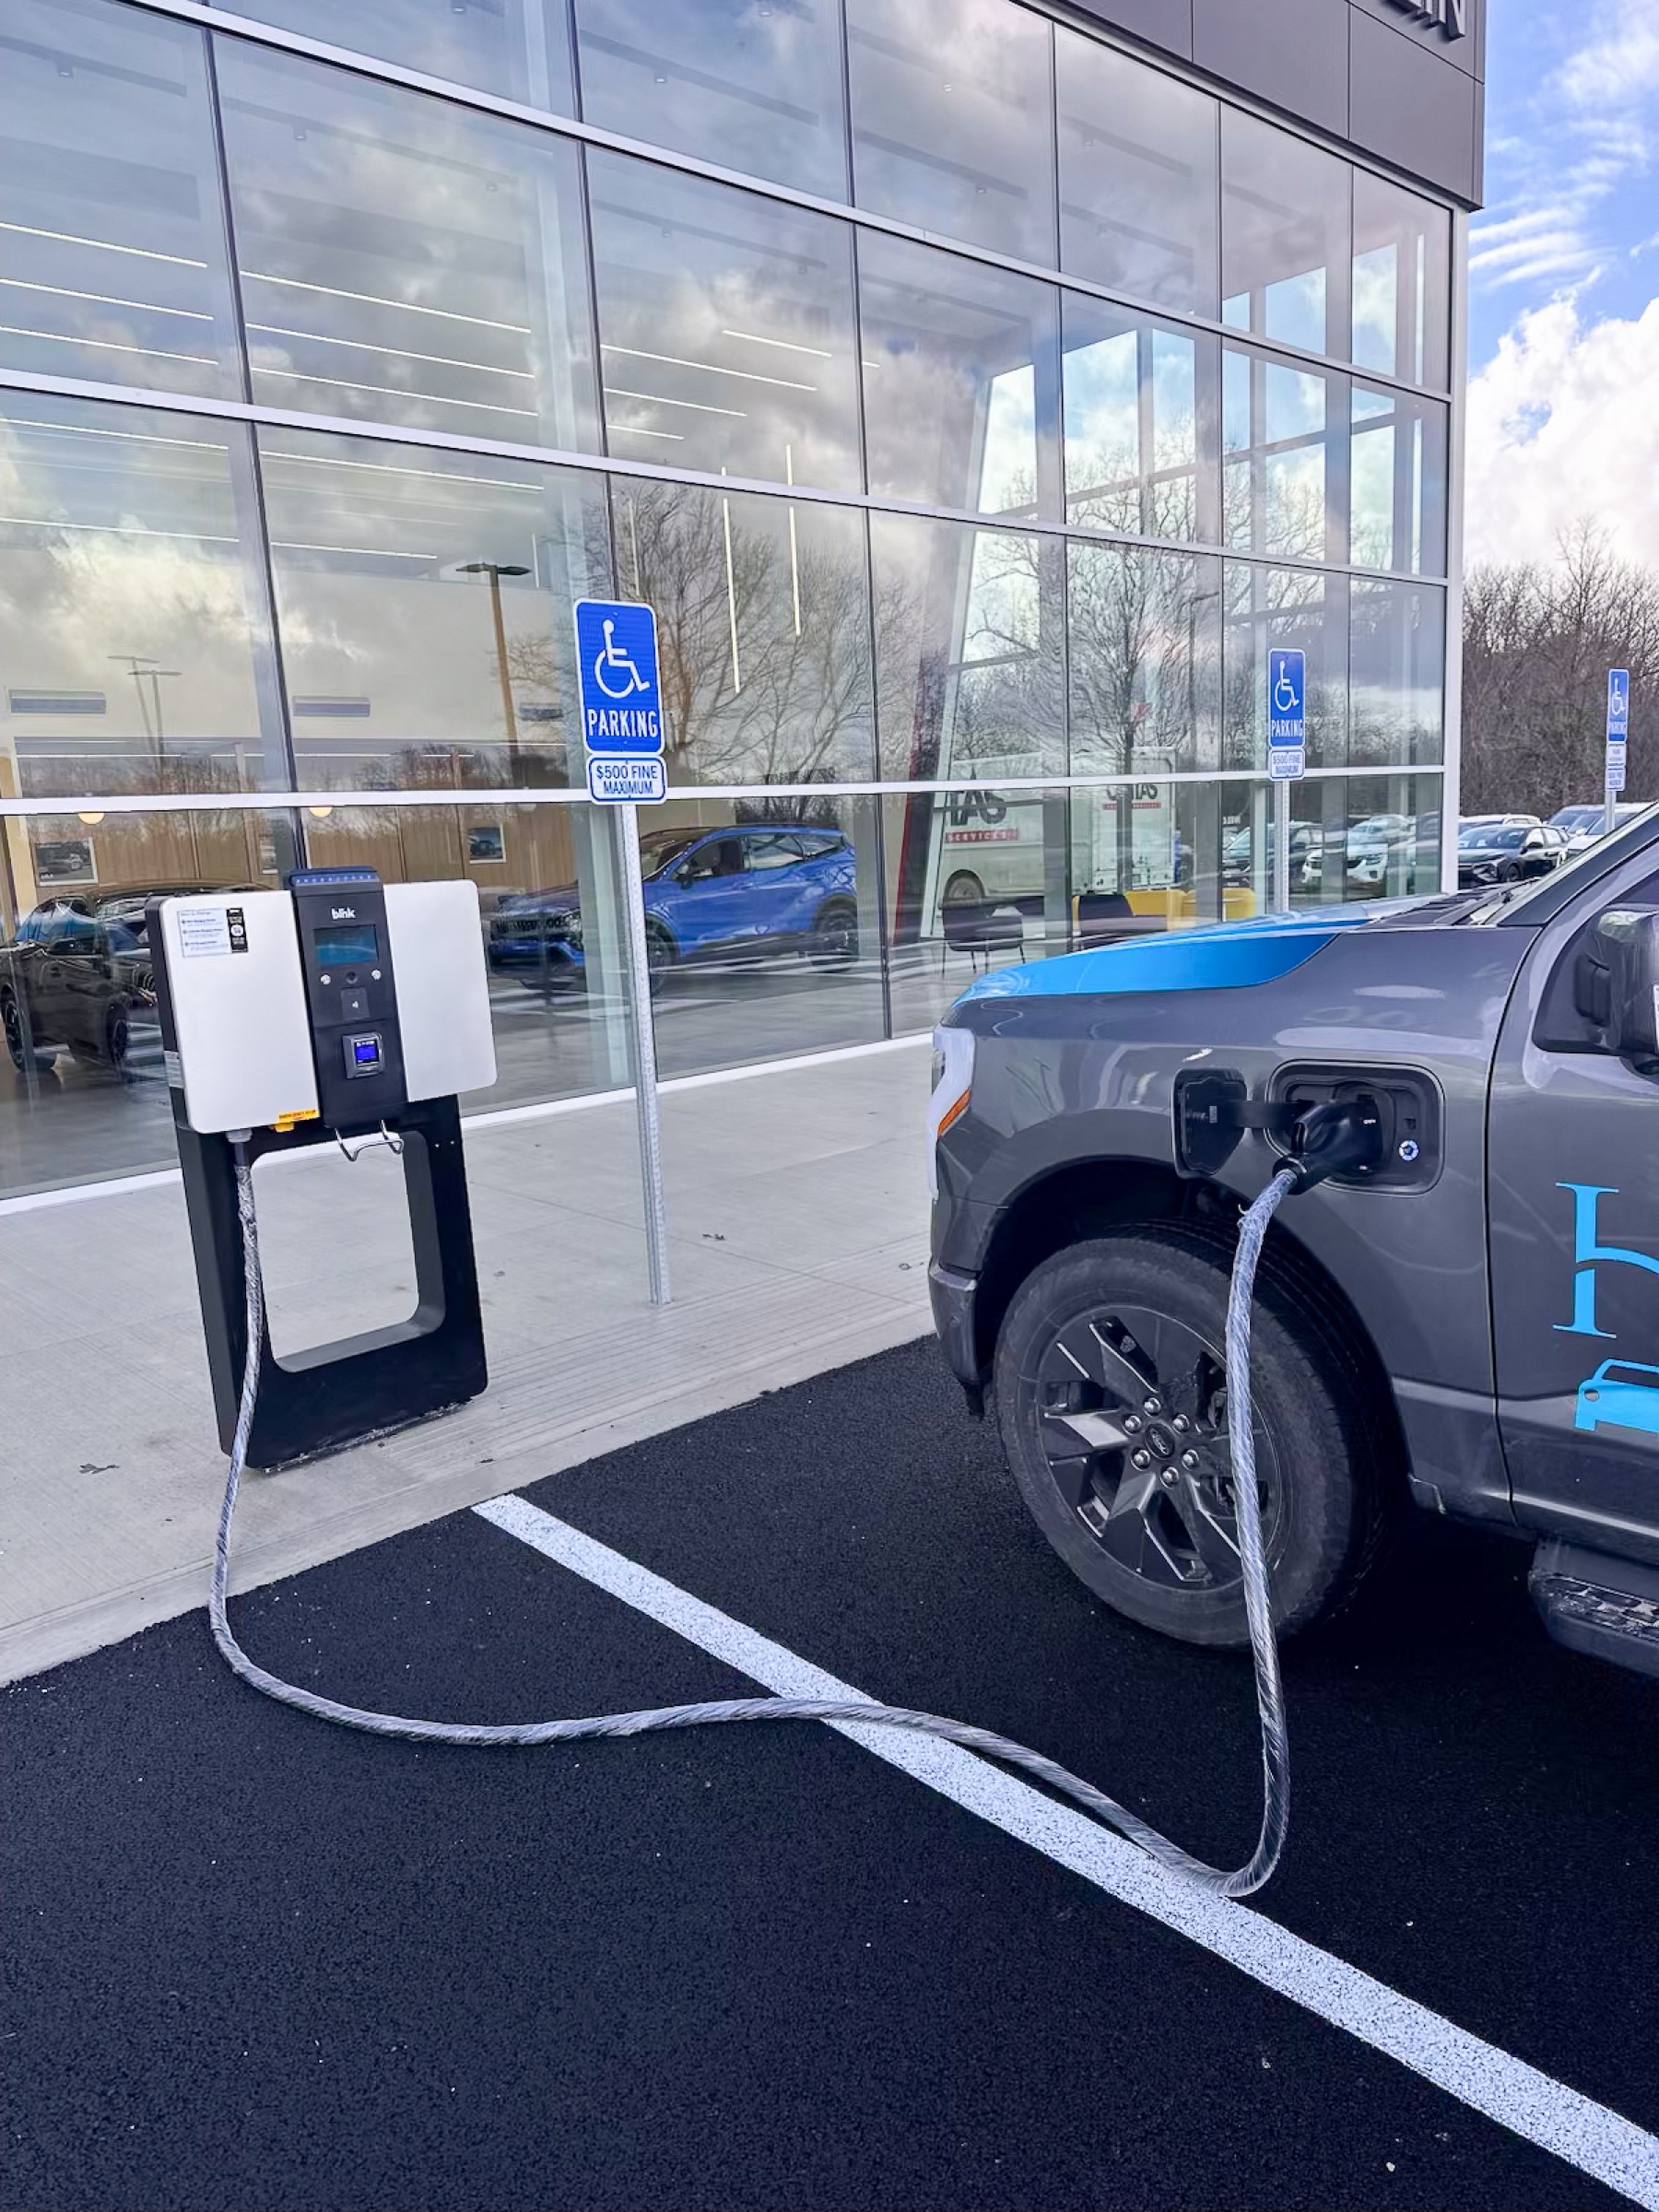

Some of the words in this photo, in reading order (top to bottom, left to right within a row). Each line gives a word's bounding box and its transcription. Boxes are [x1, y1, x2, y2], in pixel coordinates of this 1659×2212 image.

[587, 708, 658, 737] PARKING
[1271, 719, 1302, 737] PARKING
[596, 764, 629, 780] $500
[631, 765, 658, 780] FINE
[604, 781, 653, 794] MAXIMUM
[332, 907, 356, 920] blink
